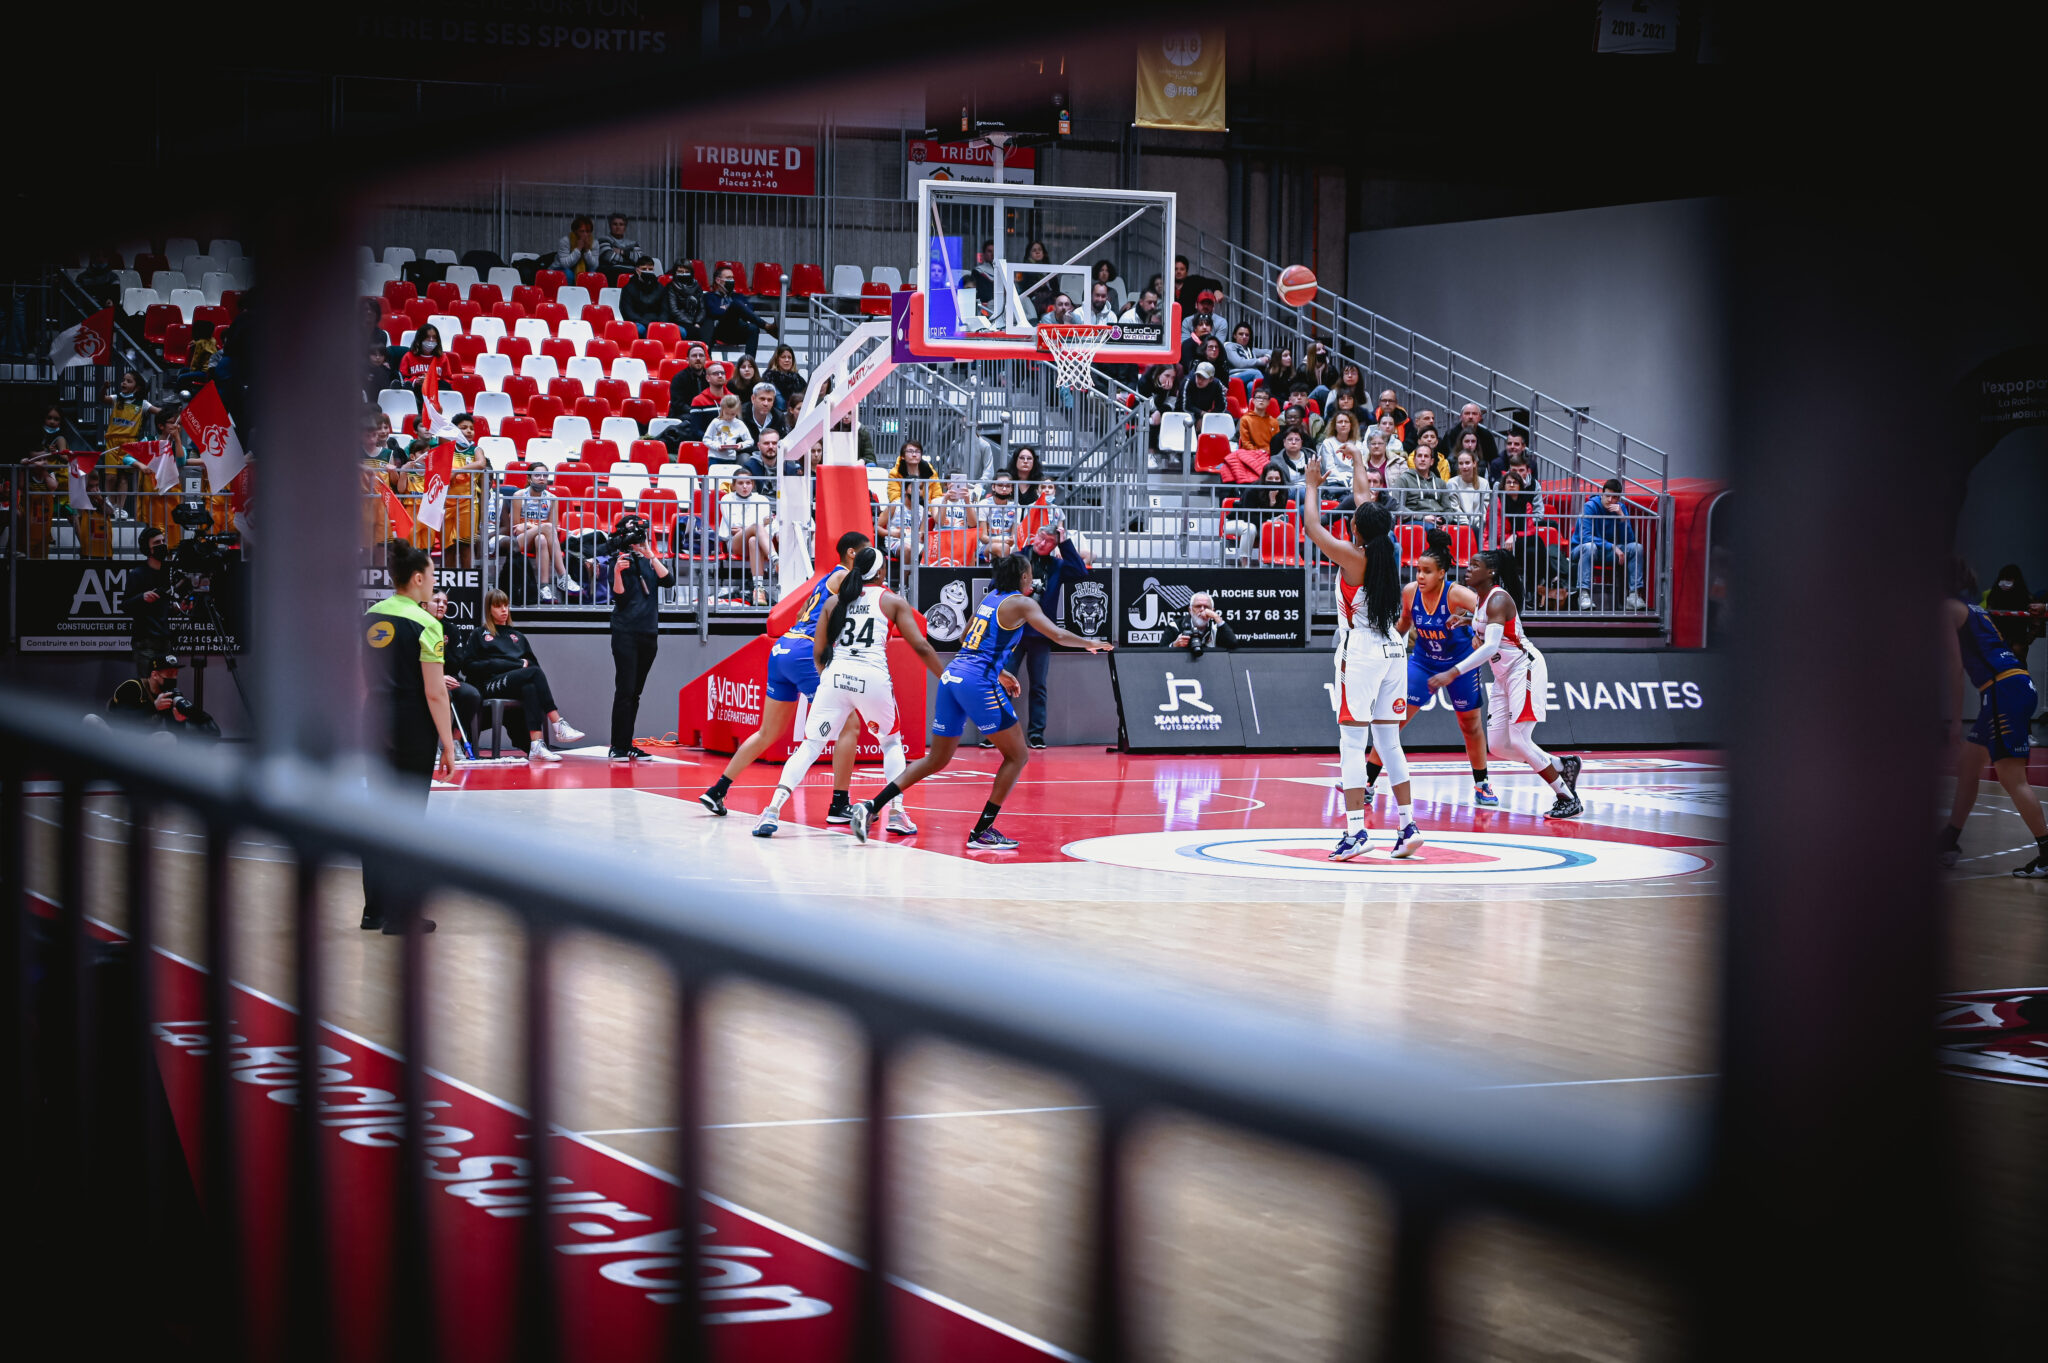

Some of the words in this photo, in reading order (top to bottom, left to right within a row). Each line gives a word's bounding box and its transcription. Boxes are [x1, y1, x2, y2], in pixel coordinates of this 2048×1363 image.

[1611, 19, 1636, 37] 2018
[1642, 22, 1666, 40] 2021
[485, 22, 531, 46] SES
[538, 25, 667, 53] SPORTIFS
[694, 146, 780, 166] TRIBUNE
[784, 146, 801, 170] D
[940, 145, 995, 162] TRIBUN
[723, 168, 752, 179] Rangs
[754, 170, 774, 178] A-N
[718, 177, 749, 187] Places
[752, 180, 778, 188] 21-40
[1123, 326, 1161, 335] EuroCup
[1982, 379, 2048, 395] l'expopa
[191, 481, 199, 489] E
[1207, 590, 1219, 598] LA
[1221, 590, 1255, 598] ROCHE
[1256, 590, 1277, 598] SUR
[1278, 590, 1299, 598] YON
[848, 604, 871, 615] CLARKE
[1226, 610, 1241, 621] 51
[1245, 610, 1261, 621] 37
[1264, 610, 1280, 621] 68
[1283, 610, 1299, 621] 35
[57, 623, 114, 631] CONSTRUCTEUR
[840, 617, 875, 648] 34
[1131, 632, 1164, 641] BATI
[98, 641, 116, 649] pour
[718, 676, 761, 711] VENDÉE
[1563, 680, 1703, 710] NANTES
[723, 707, 760, 726] DÉPARTEMENT
[1153, 715, 1180, 725] JEAN
[1182, 714, 1222, 724] ROUYER
